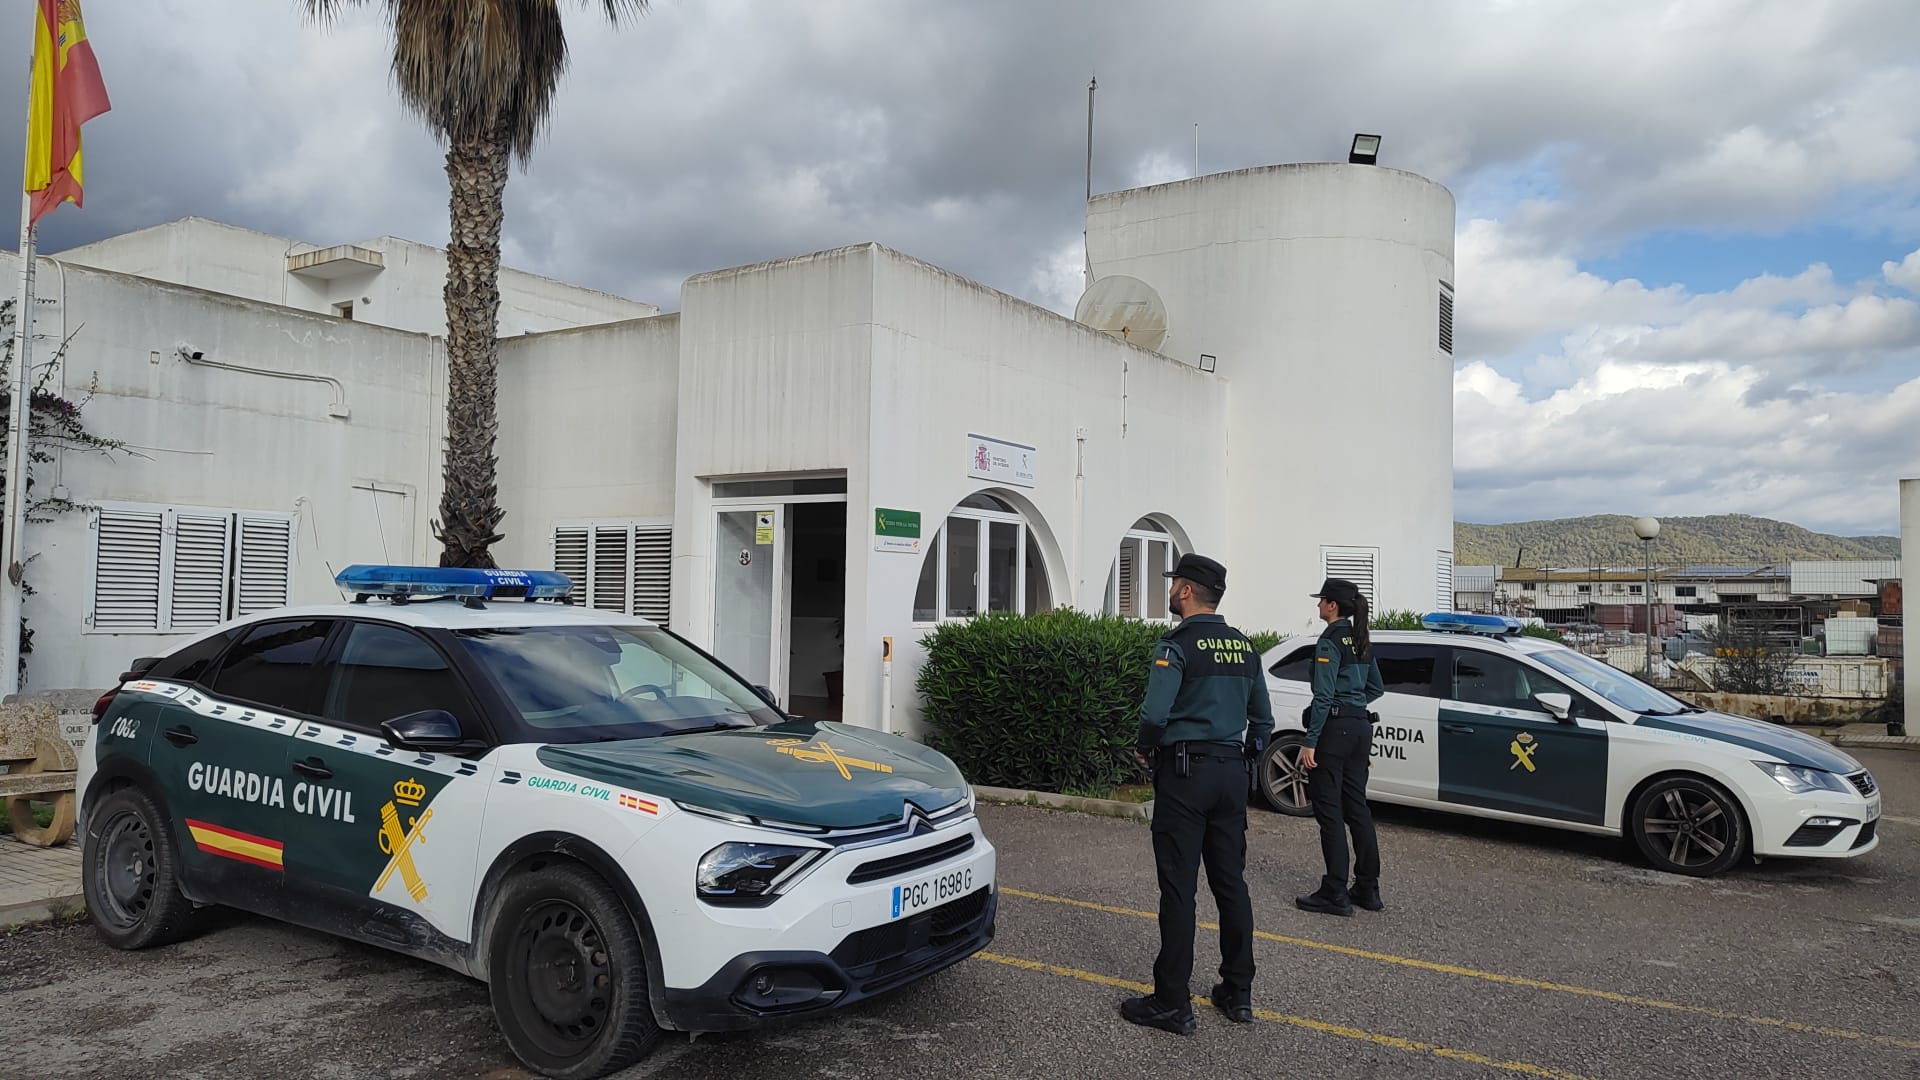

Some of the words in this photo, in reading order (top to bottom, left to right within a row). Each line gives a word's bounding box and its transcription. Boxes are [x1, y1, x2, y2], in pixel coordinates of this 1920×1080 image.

[1197, 638, 1253, 653] GUARDIA
[1214, 652, 1245, 663] CIVIL
[66, 725, 84, 734] QUE
[1369, 743, 1407, 760] CIVIL
[188, 761, 285, 809] GUARDIA
[292, 782, 356, 824] CIVIL
[528, 776, 577, 793] GUARDIA
[580, 786, 611, 801] CIVIL
[902, 881, 929, 912] PGC
[934, 871, 963, 902] 1698
[965, 868, 972, 890] G
